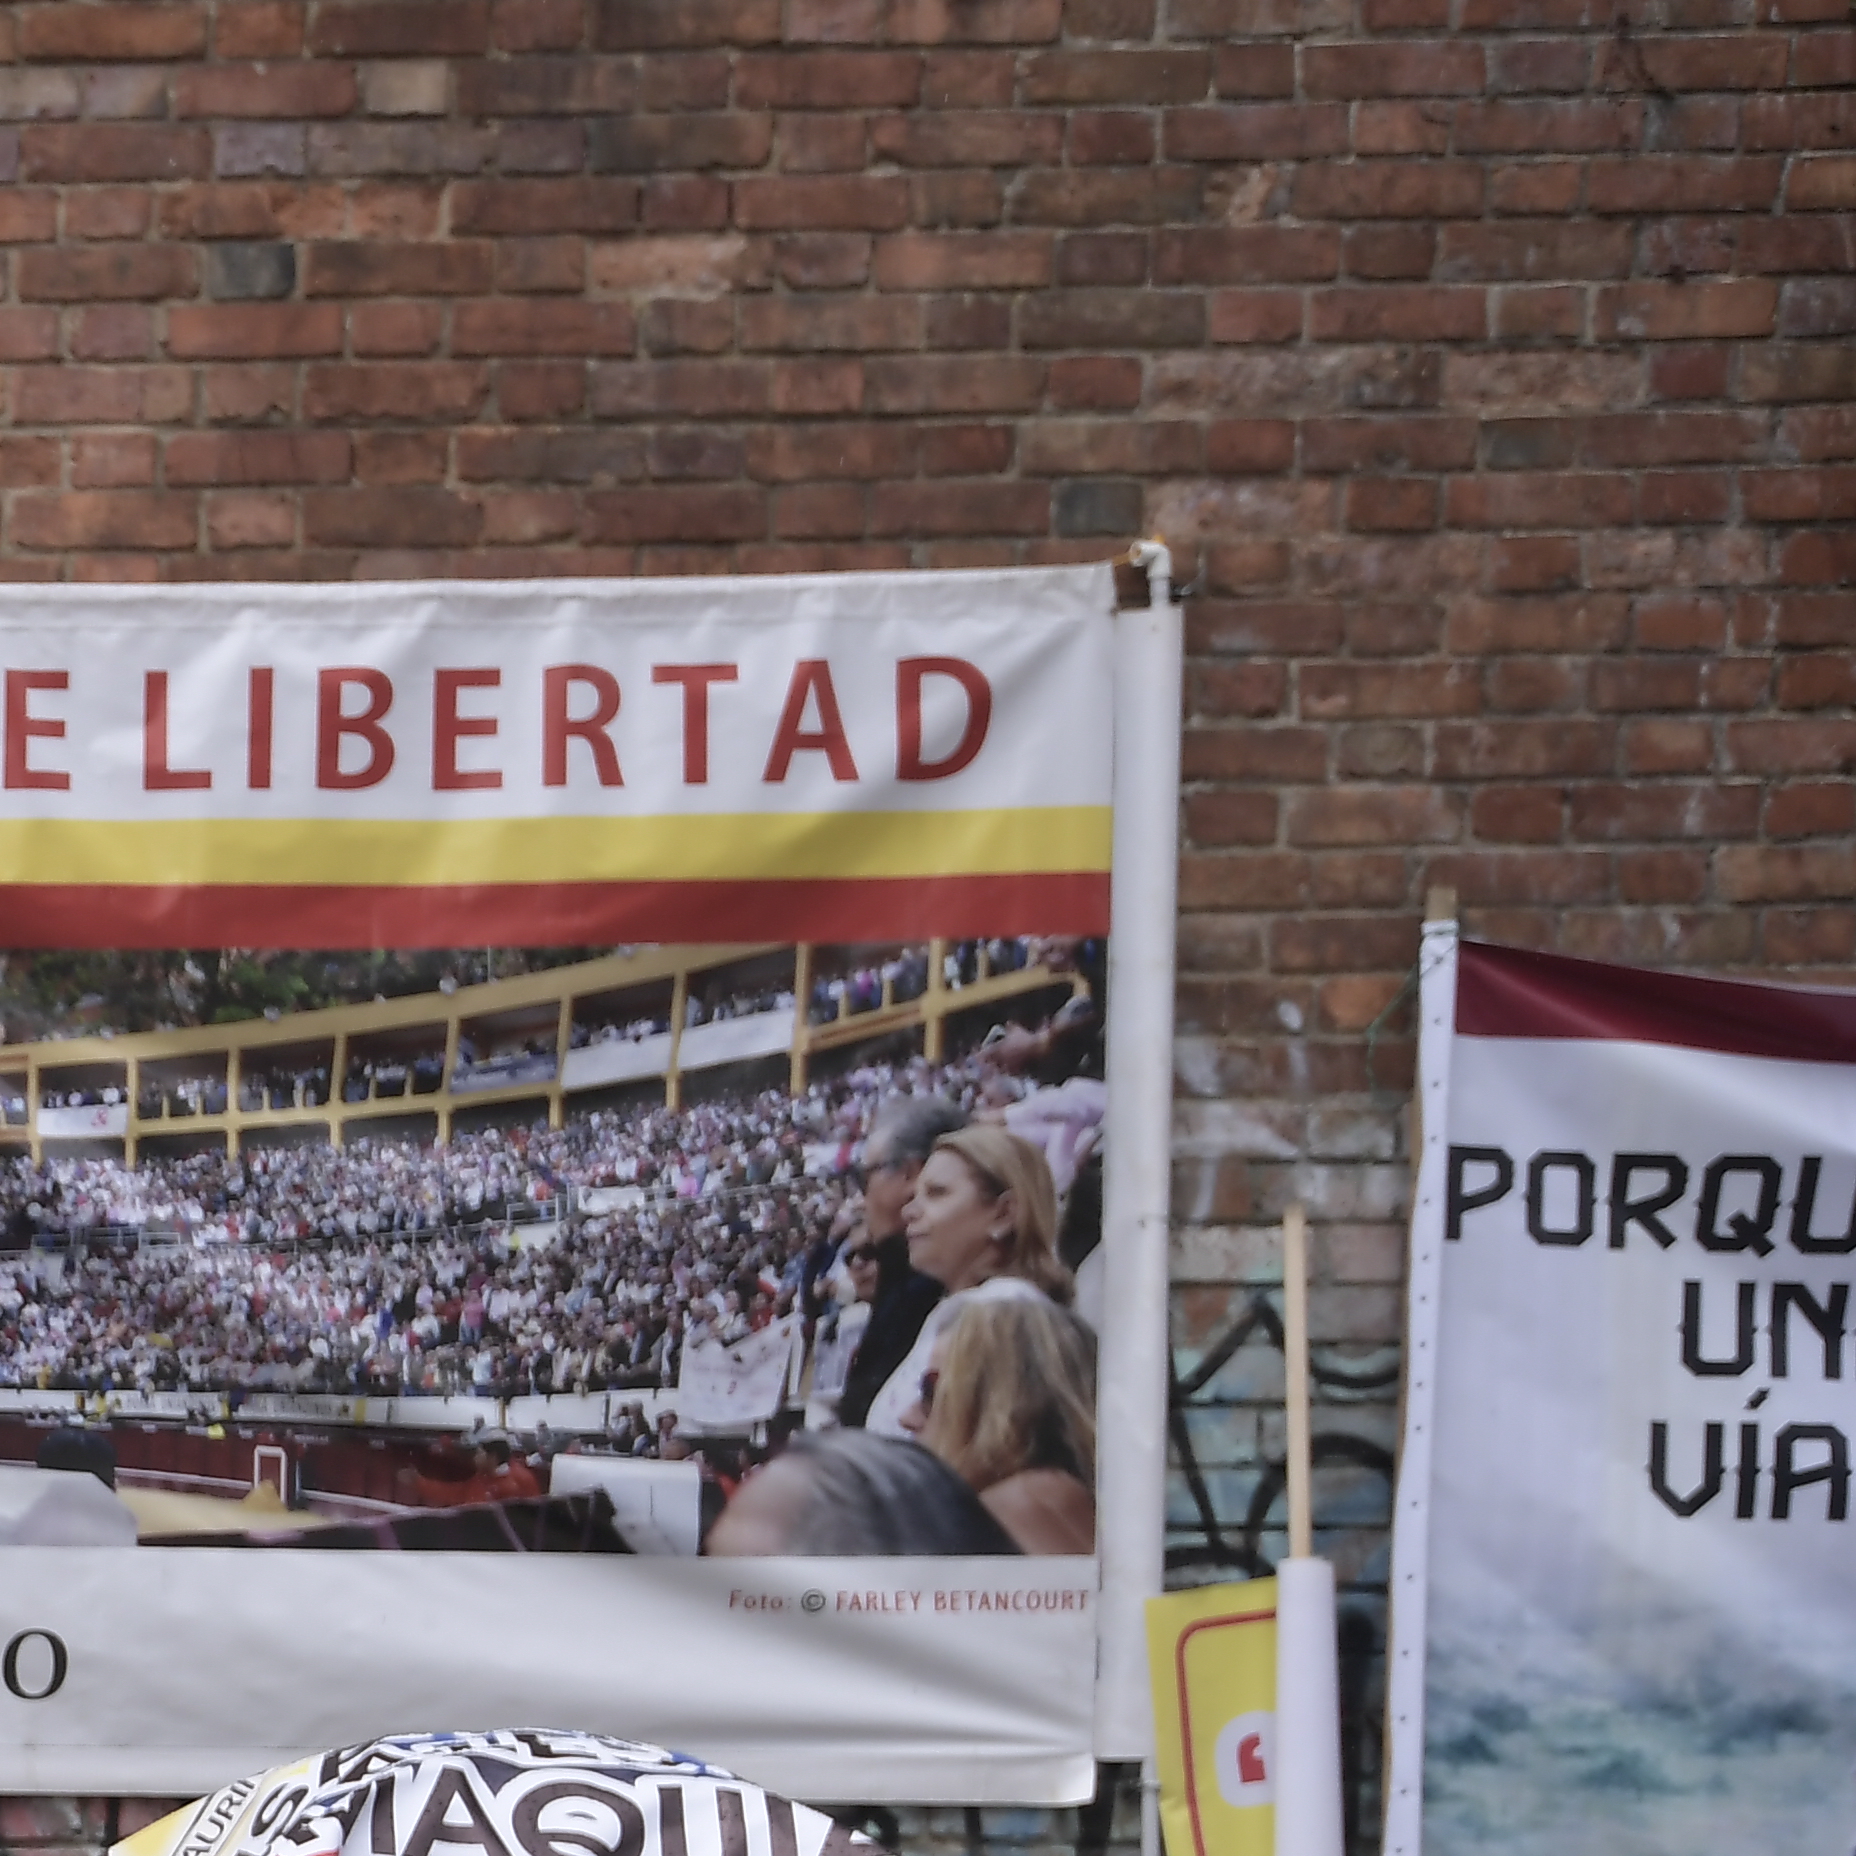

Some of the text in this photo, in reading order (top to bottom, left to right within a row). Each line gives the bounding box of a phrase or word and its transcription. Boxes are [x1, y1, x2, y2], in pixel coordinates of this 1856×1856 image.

[141, 655, 994, 792] LIBERTAD
[1678, 1280, 1856, 1381] UN
[835, 1589, 922, 1613] FARLEY
[933, 1588, 1090, 1613] BETANCOURT
